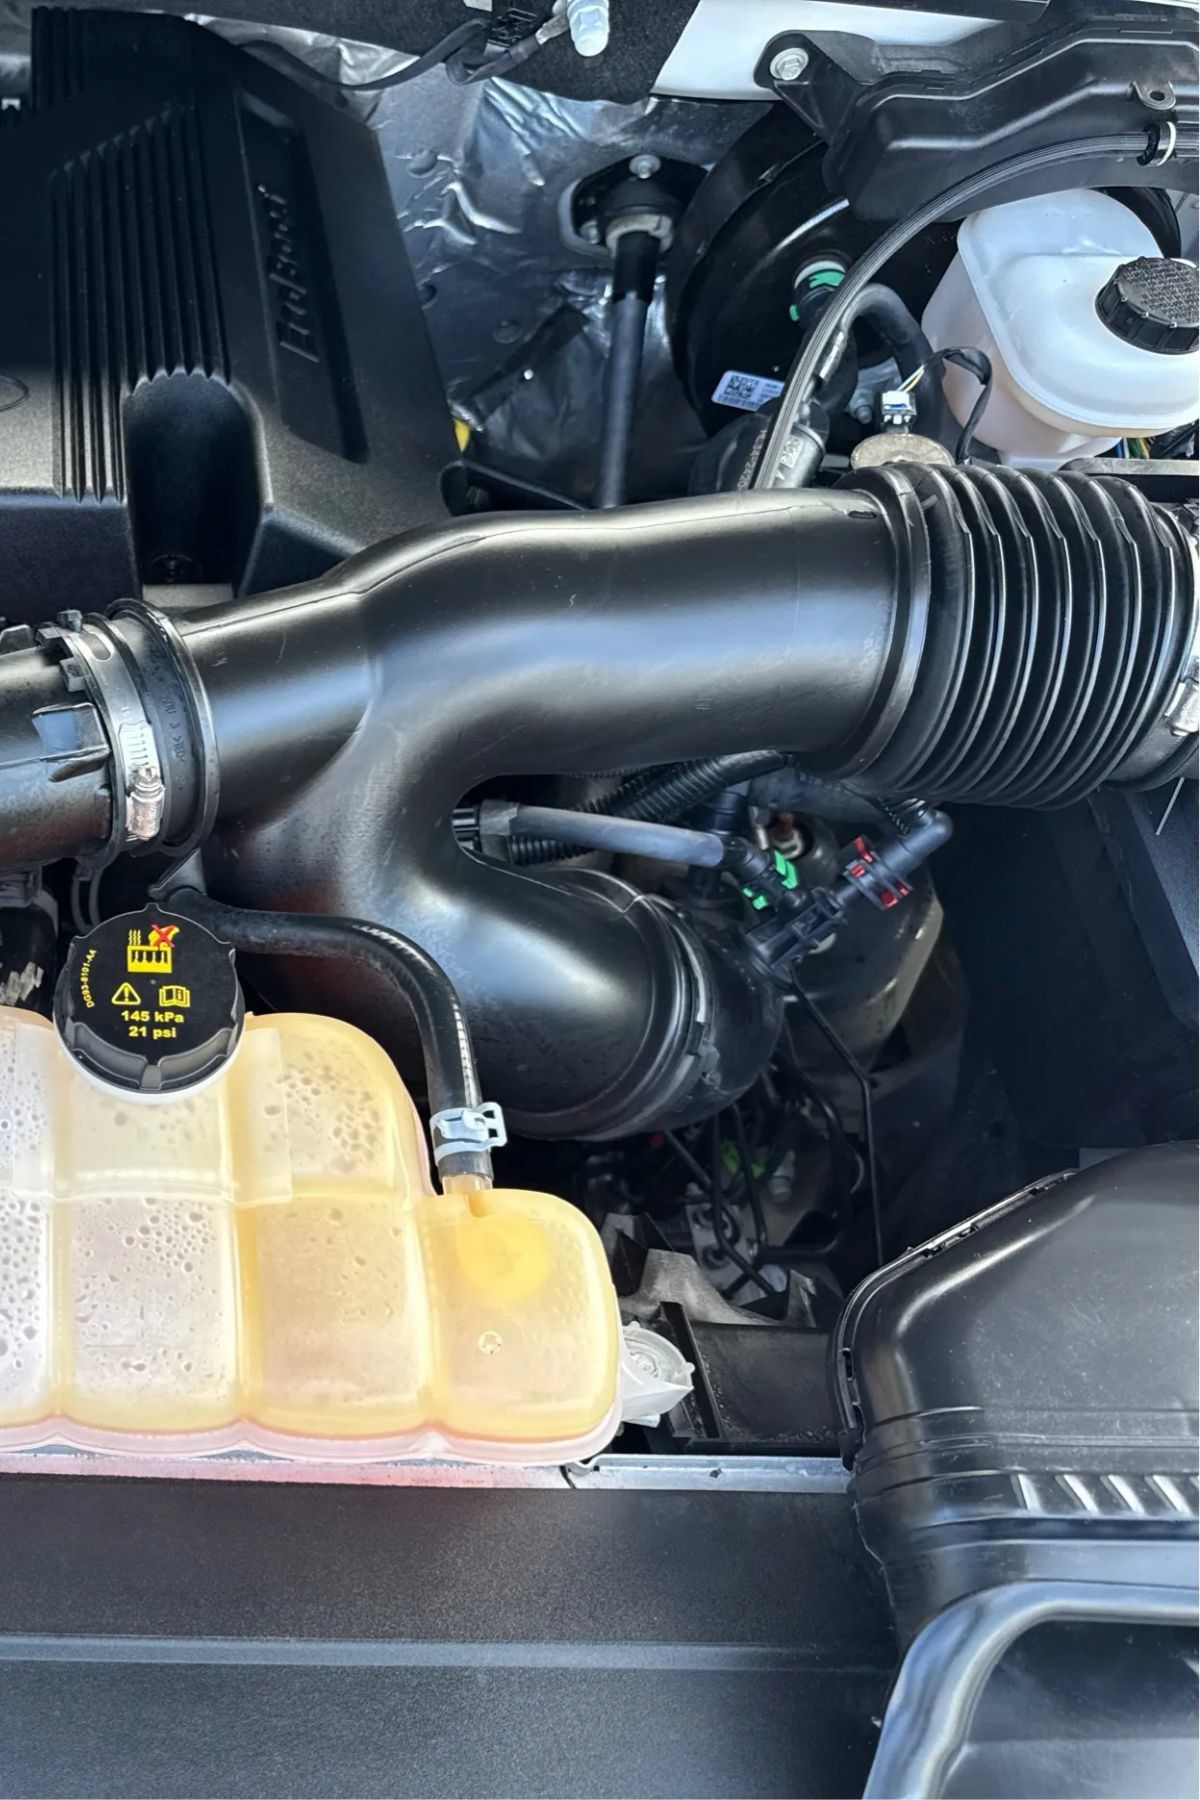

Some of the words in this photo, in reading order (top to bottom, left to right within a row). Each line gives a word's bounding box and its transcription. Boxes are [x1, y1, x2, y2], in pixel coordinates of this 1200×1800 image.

[121, 1010, 150, 1022] 145
[154, 1010, 185, 1023] kPa
[128, 1026, 147, 1038] 21
[152, 1026, 177, 1039] psi
